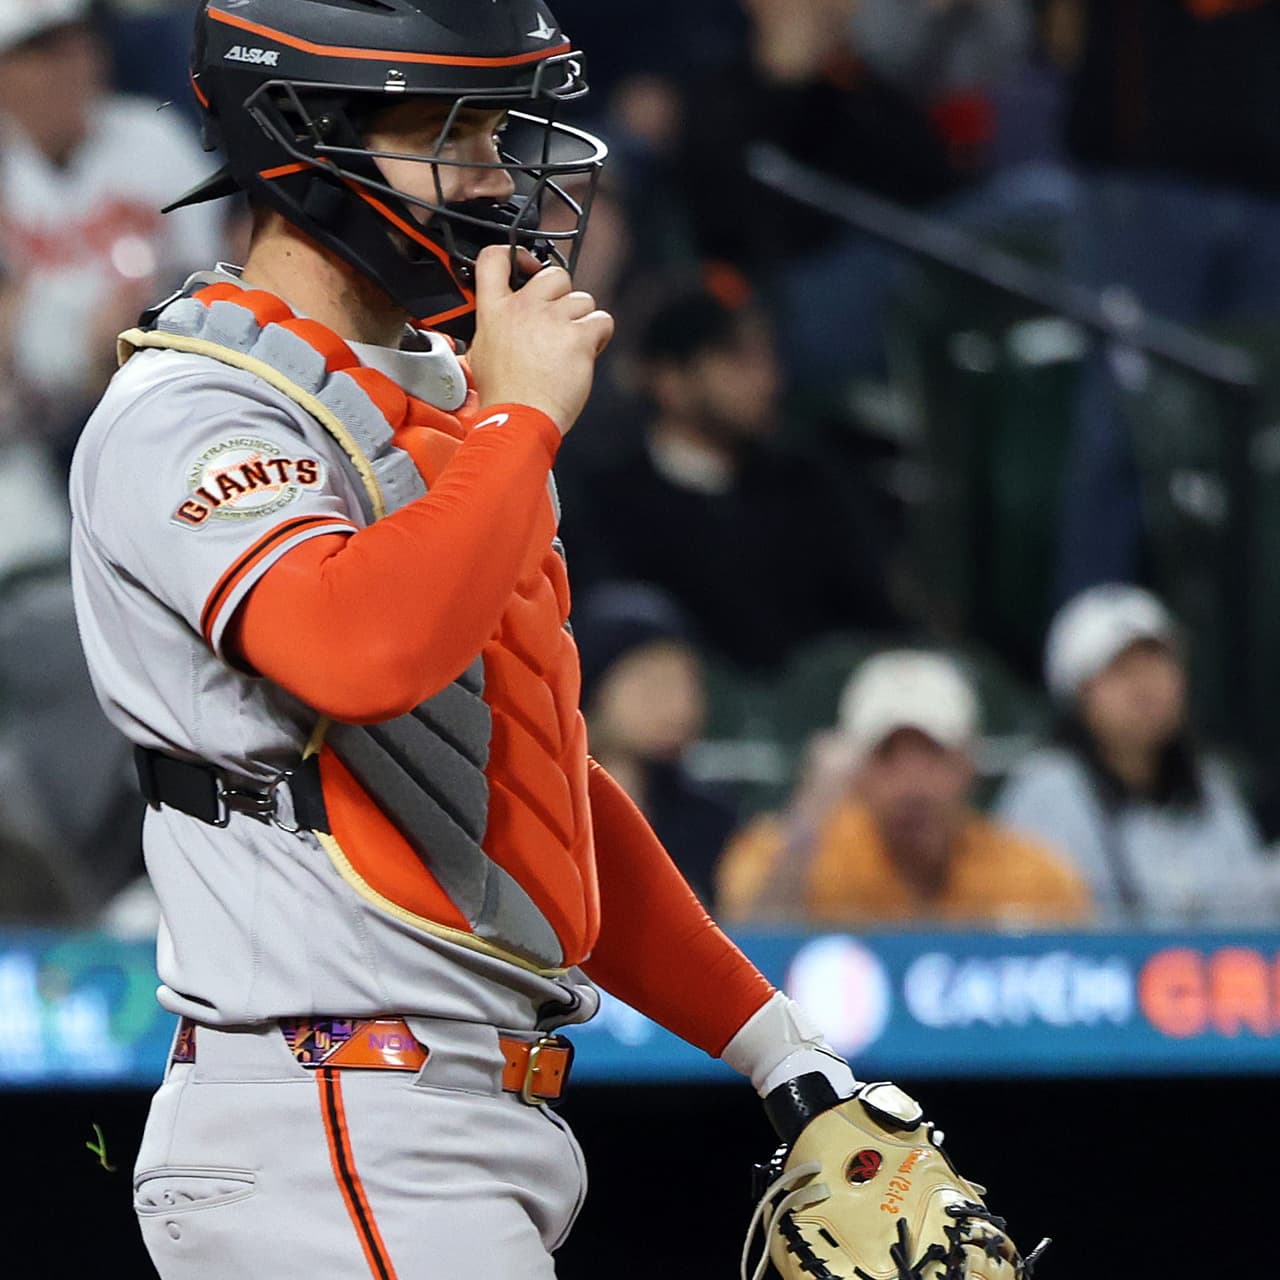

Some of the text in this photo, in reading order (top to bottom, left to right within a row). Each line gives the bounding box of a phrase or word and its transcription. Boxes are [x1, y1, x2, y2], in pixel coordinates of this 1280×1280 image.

[203, 438, 281, 459] FRANCISCO
[175, 457, 320, 525] GIANTS
[904, 947, 1280, 1038] CATCH GR
